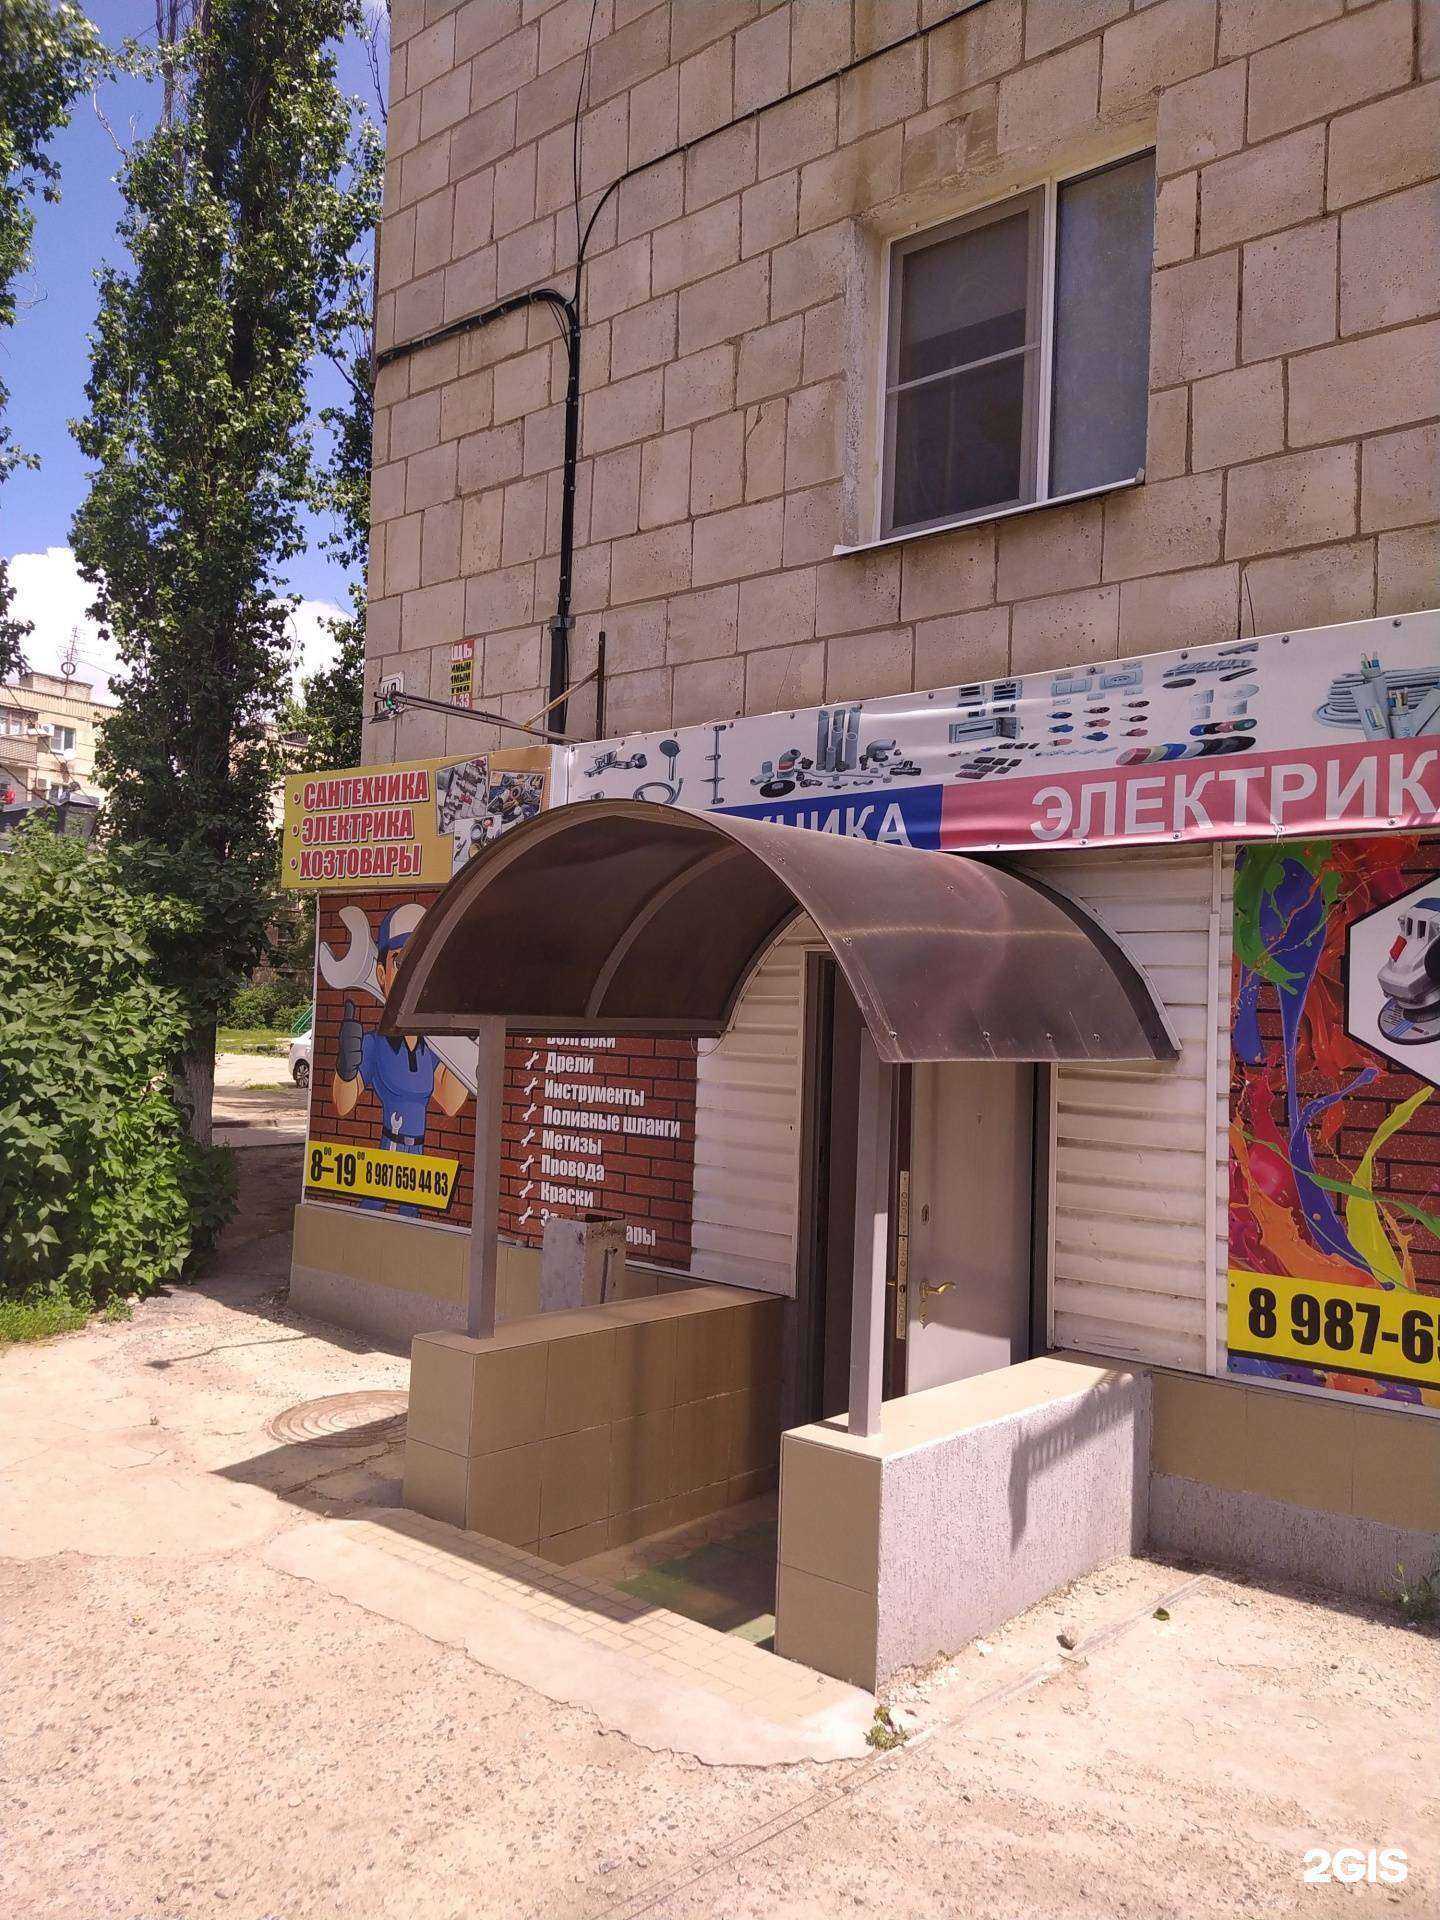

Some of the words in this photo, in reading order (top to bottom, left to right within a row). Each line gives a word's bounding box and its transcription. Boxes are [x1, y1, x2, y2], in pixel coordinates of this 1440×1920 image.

[304, 771, 429, 809] САНТЕХНИКА
[1030, 750, 1440, 841] ЭЛЕКТРИК
[301, 809, 413, 844] ЭЛЕКТРИКА
[300, 844, 421, 879] ХОЗТОВАРЫ
[545, 1052, 594, 1074] Дрели
[544, 1079, 645, 1106] Инструменты
[542, 1105, 620, 1131] Поливные
[623, 1117, 681, 1138] шланги
[541, 1130, 602, 1155] Метизы
[541, 1154, 605, 1181] Провода
[540, 1181, 595, 1207] Краски
[1249, 1287, 1277, 1338] 8
[1291, 1293, 1440, 1364] 987-6
